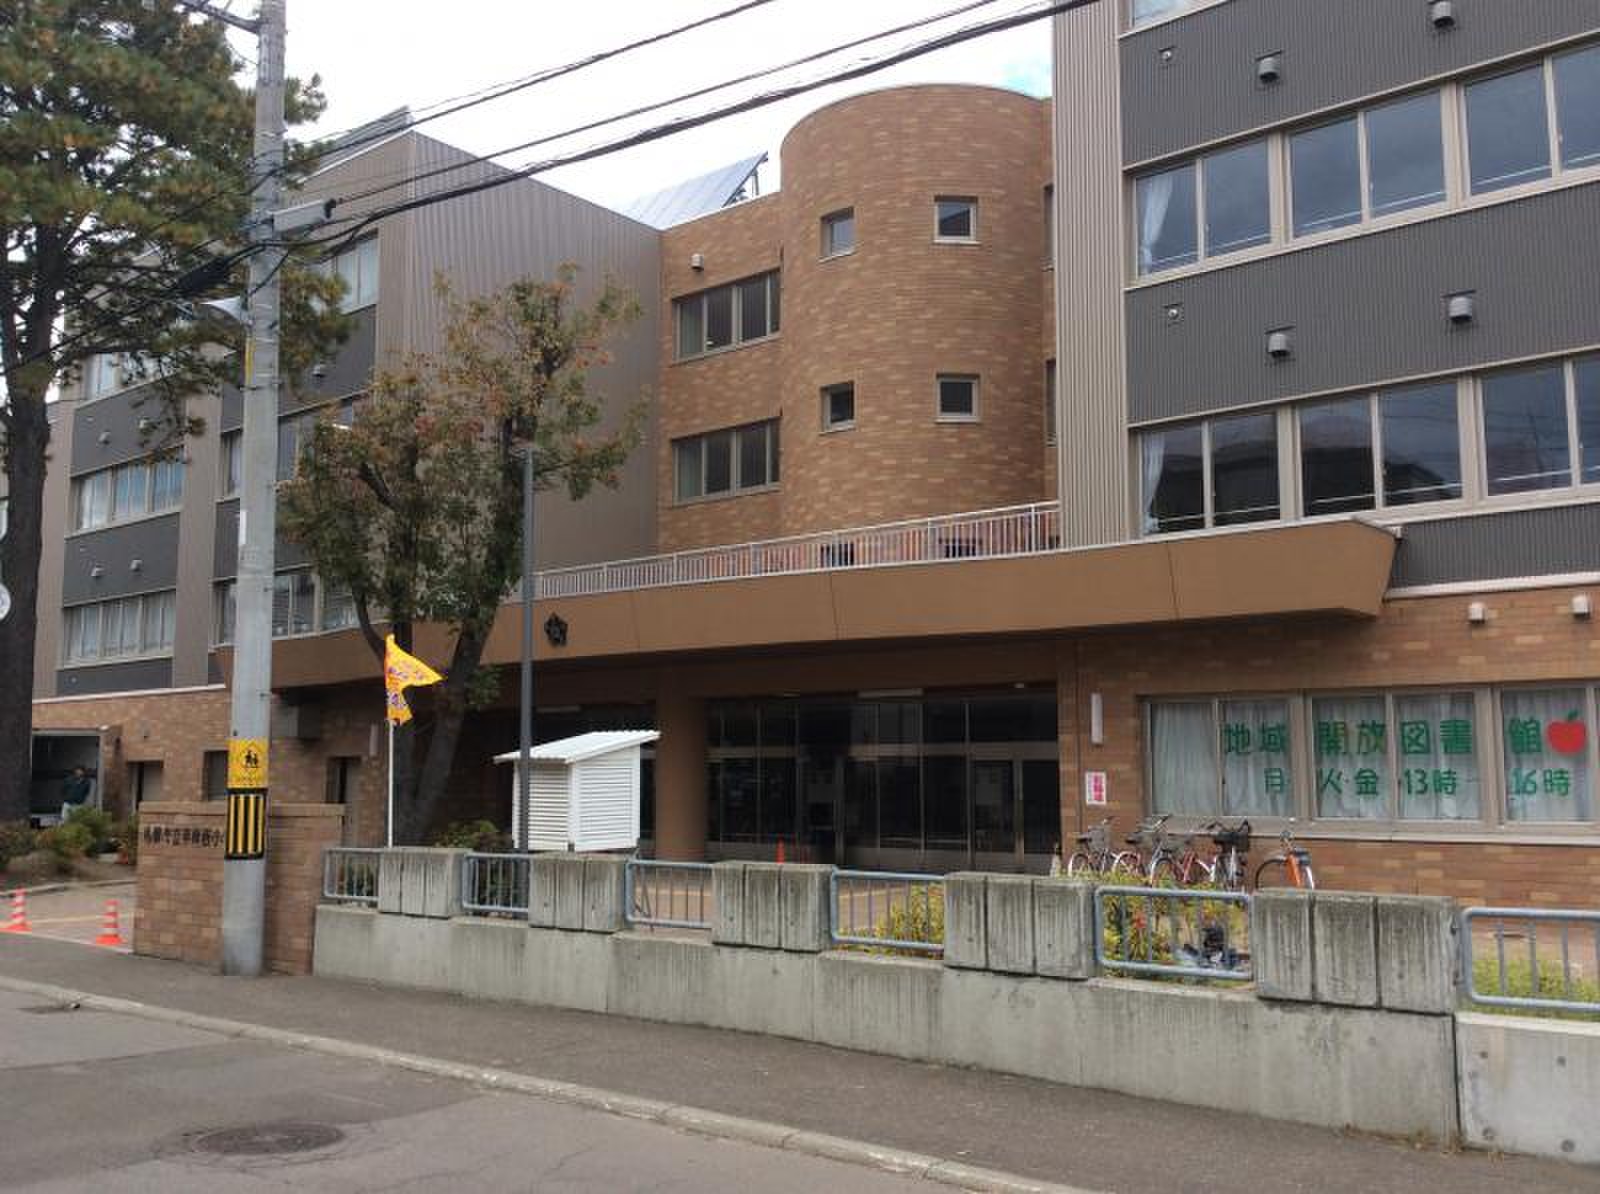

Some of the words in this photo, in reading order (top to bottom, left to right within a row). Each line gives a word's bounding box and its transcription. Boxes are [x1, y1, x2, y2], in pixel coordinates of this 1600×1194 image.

[1223, 717, 1542, 756] 地域開放図書館
